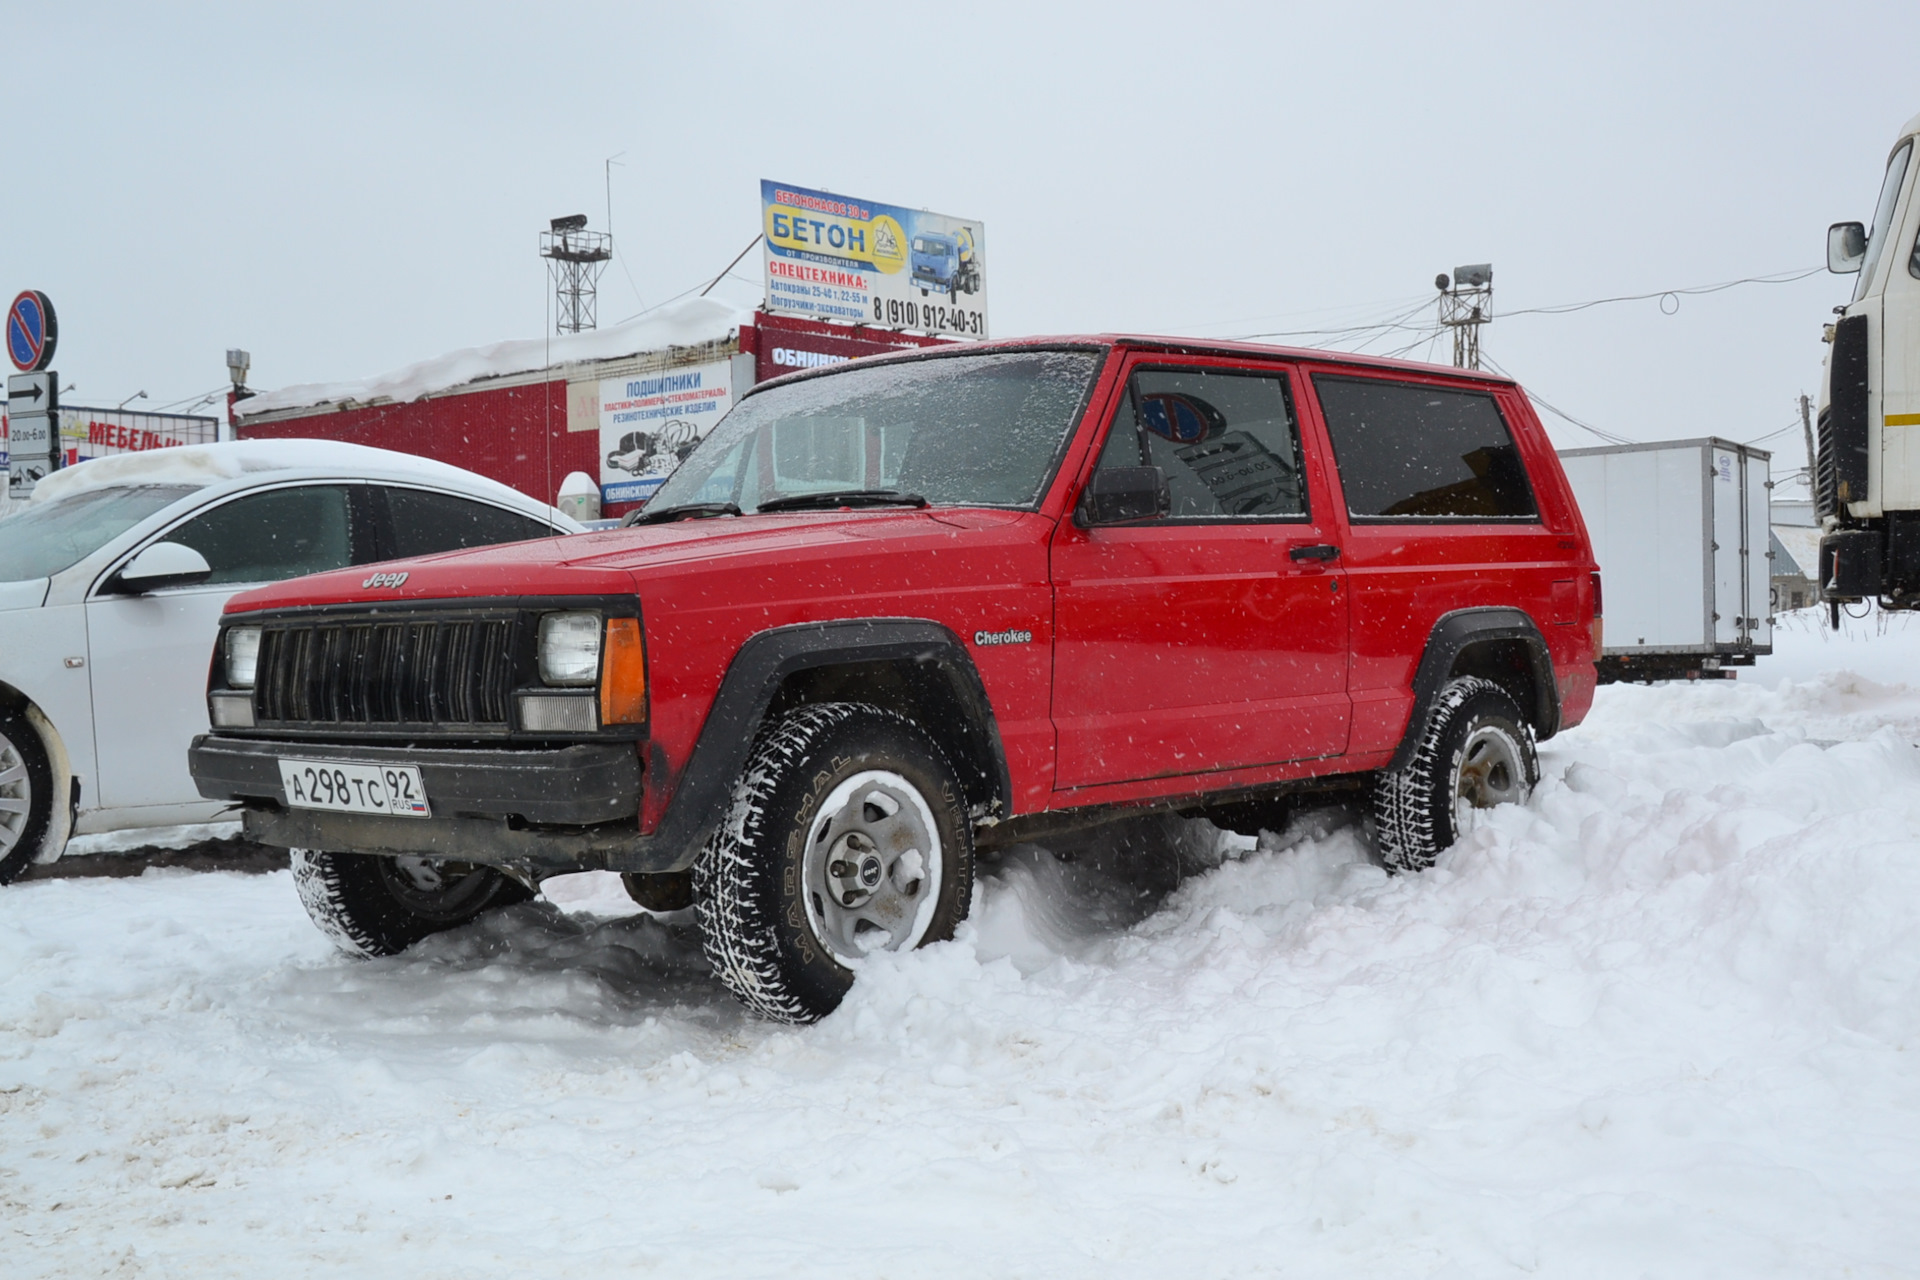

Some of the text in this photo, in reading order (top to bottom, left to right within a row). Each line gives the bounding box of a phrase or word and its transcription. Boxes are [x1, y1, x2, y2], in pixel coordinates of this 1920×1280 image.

[775, 189, 846, 215] БЕТОНОНАСОС
[848, 204, 860, 218] 30
[773, 212, 865, 252] БЕТОН
[786, 249, 859, 268] ОТ ПРОИЗВОДИТЕЛЯ
[769, 261, 867, 289] СПЕЦТЕХНИКА:
[770, 279, 811, 295] Автокраны
[841, 290, 861, 303] 22-55
[770, 294, 864, 318] Погрузчики-экскаваторы
[873, 296, 983, 335] 8 (910) 912-40-31
[626, 372, 701, 398] ПОДШИПНИКИ
[613, 405, 683, 424] РЕЗИНОТЕХНИЧЕСКИЕ
[684, 401, 716, 415] ИЗДЕЛИЯ
[362, 571, 409, 589] Jeep
[974, 628, 1032, 646] Cherokee
[292, 767, 415, 808] А298ТС 92
[392, 799, 411, 810] RUS
[784, 756, 850, 964] MARSHAL
[941, 780, 968, 926] VENTU
